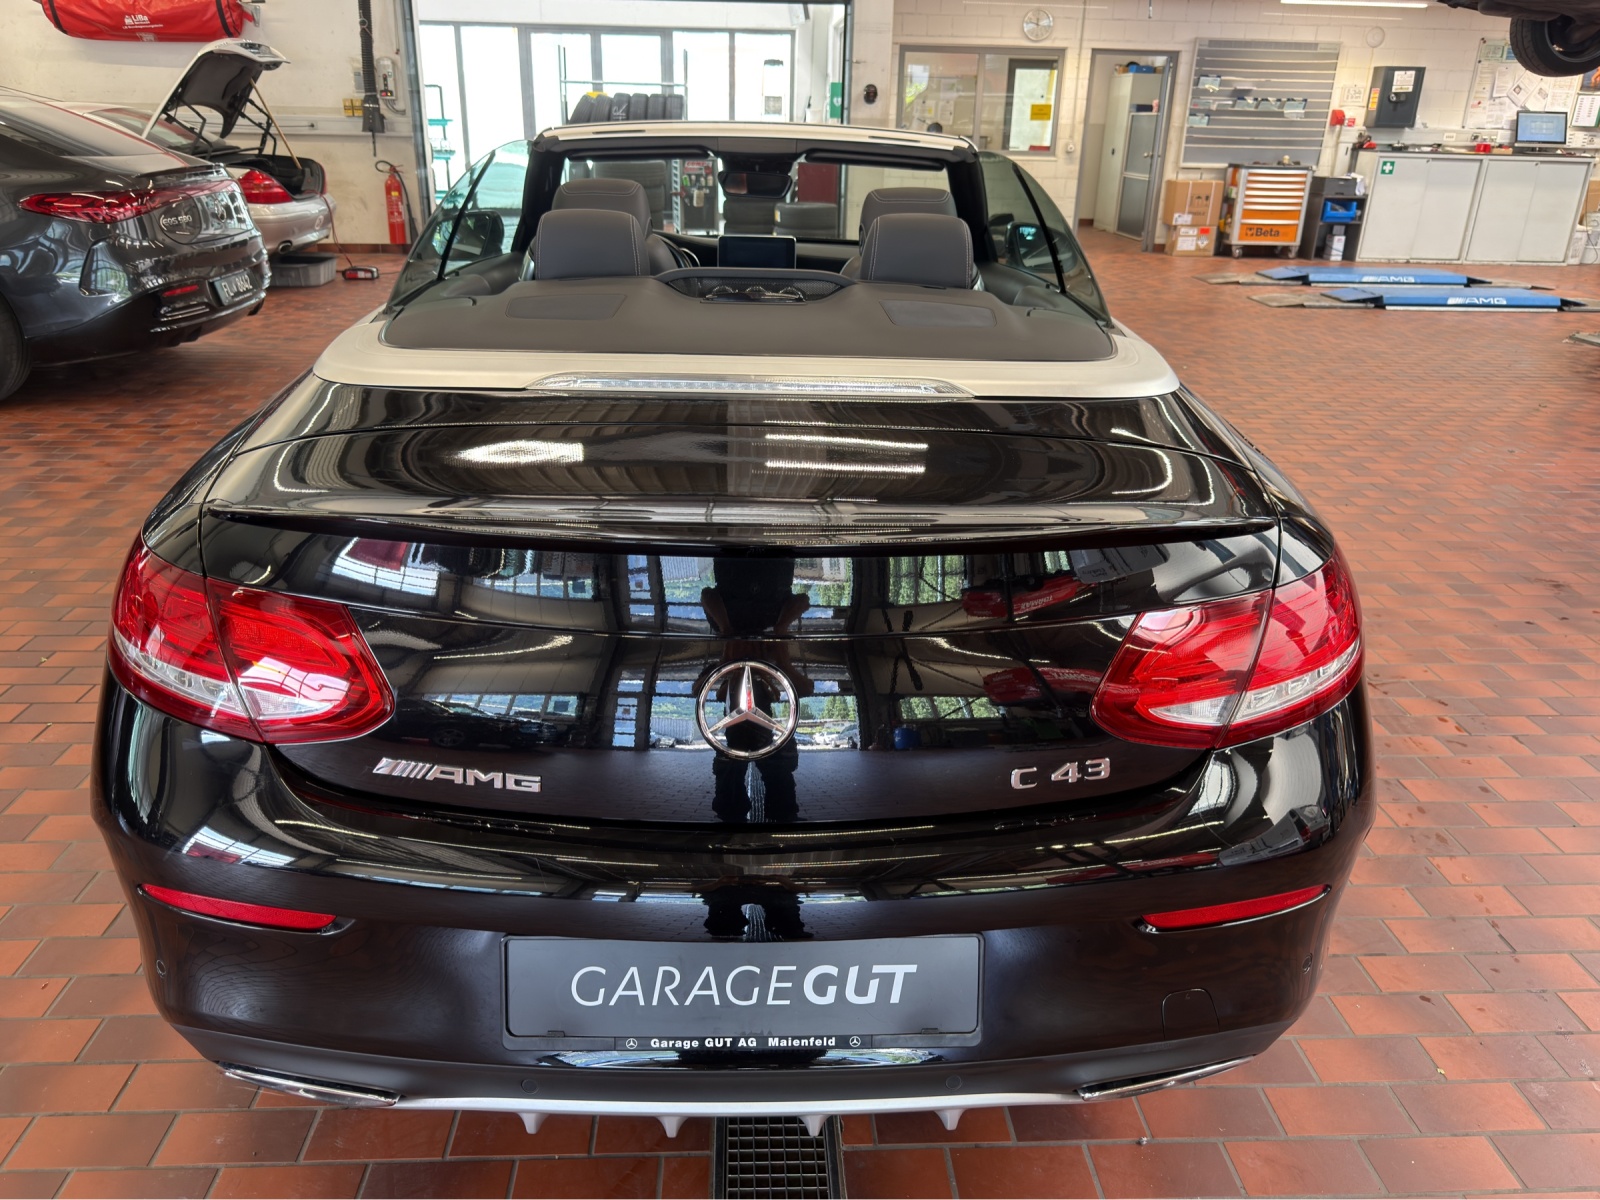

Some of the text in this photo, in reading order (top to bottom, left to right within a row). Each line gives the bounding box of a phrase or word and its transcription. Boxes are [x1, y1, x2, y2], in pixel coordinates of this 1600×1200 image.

[178, 214, 192, 224] 580
[1255, 227, 1280, 237] Beta
[1465, 297, 1507, 305] AMG
[425, 764, 541, 793] AMG
[1010, 757, 1111, 790] C 43
[650, 1036, 836, 1050] Garage GUT AG Maienfeld
